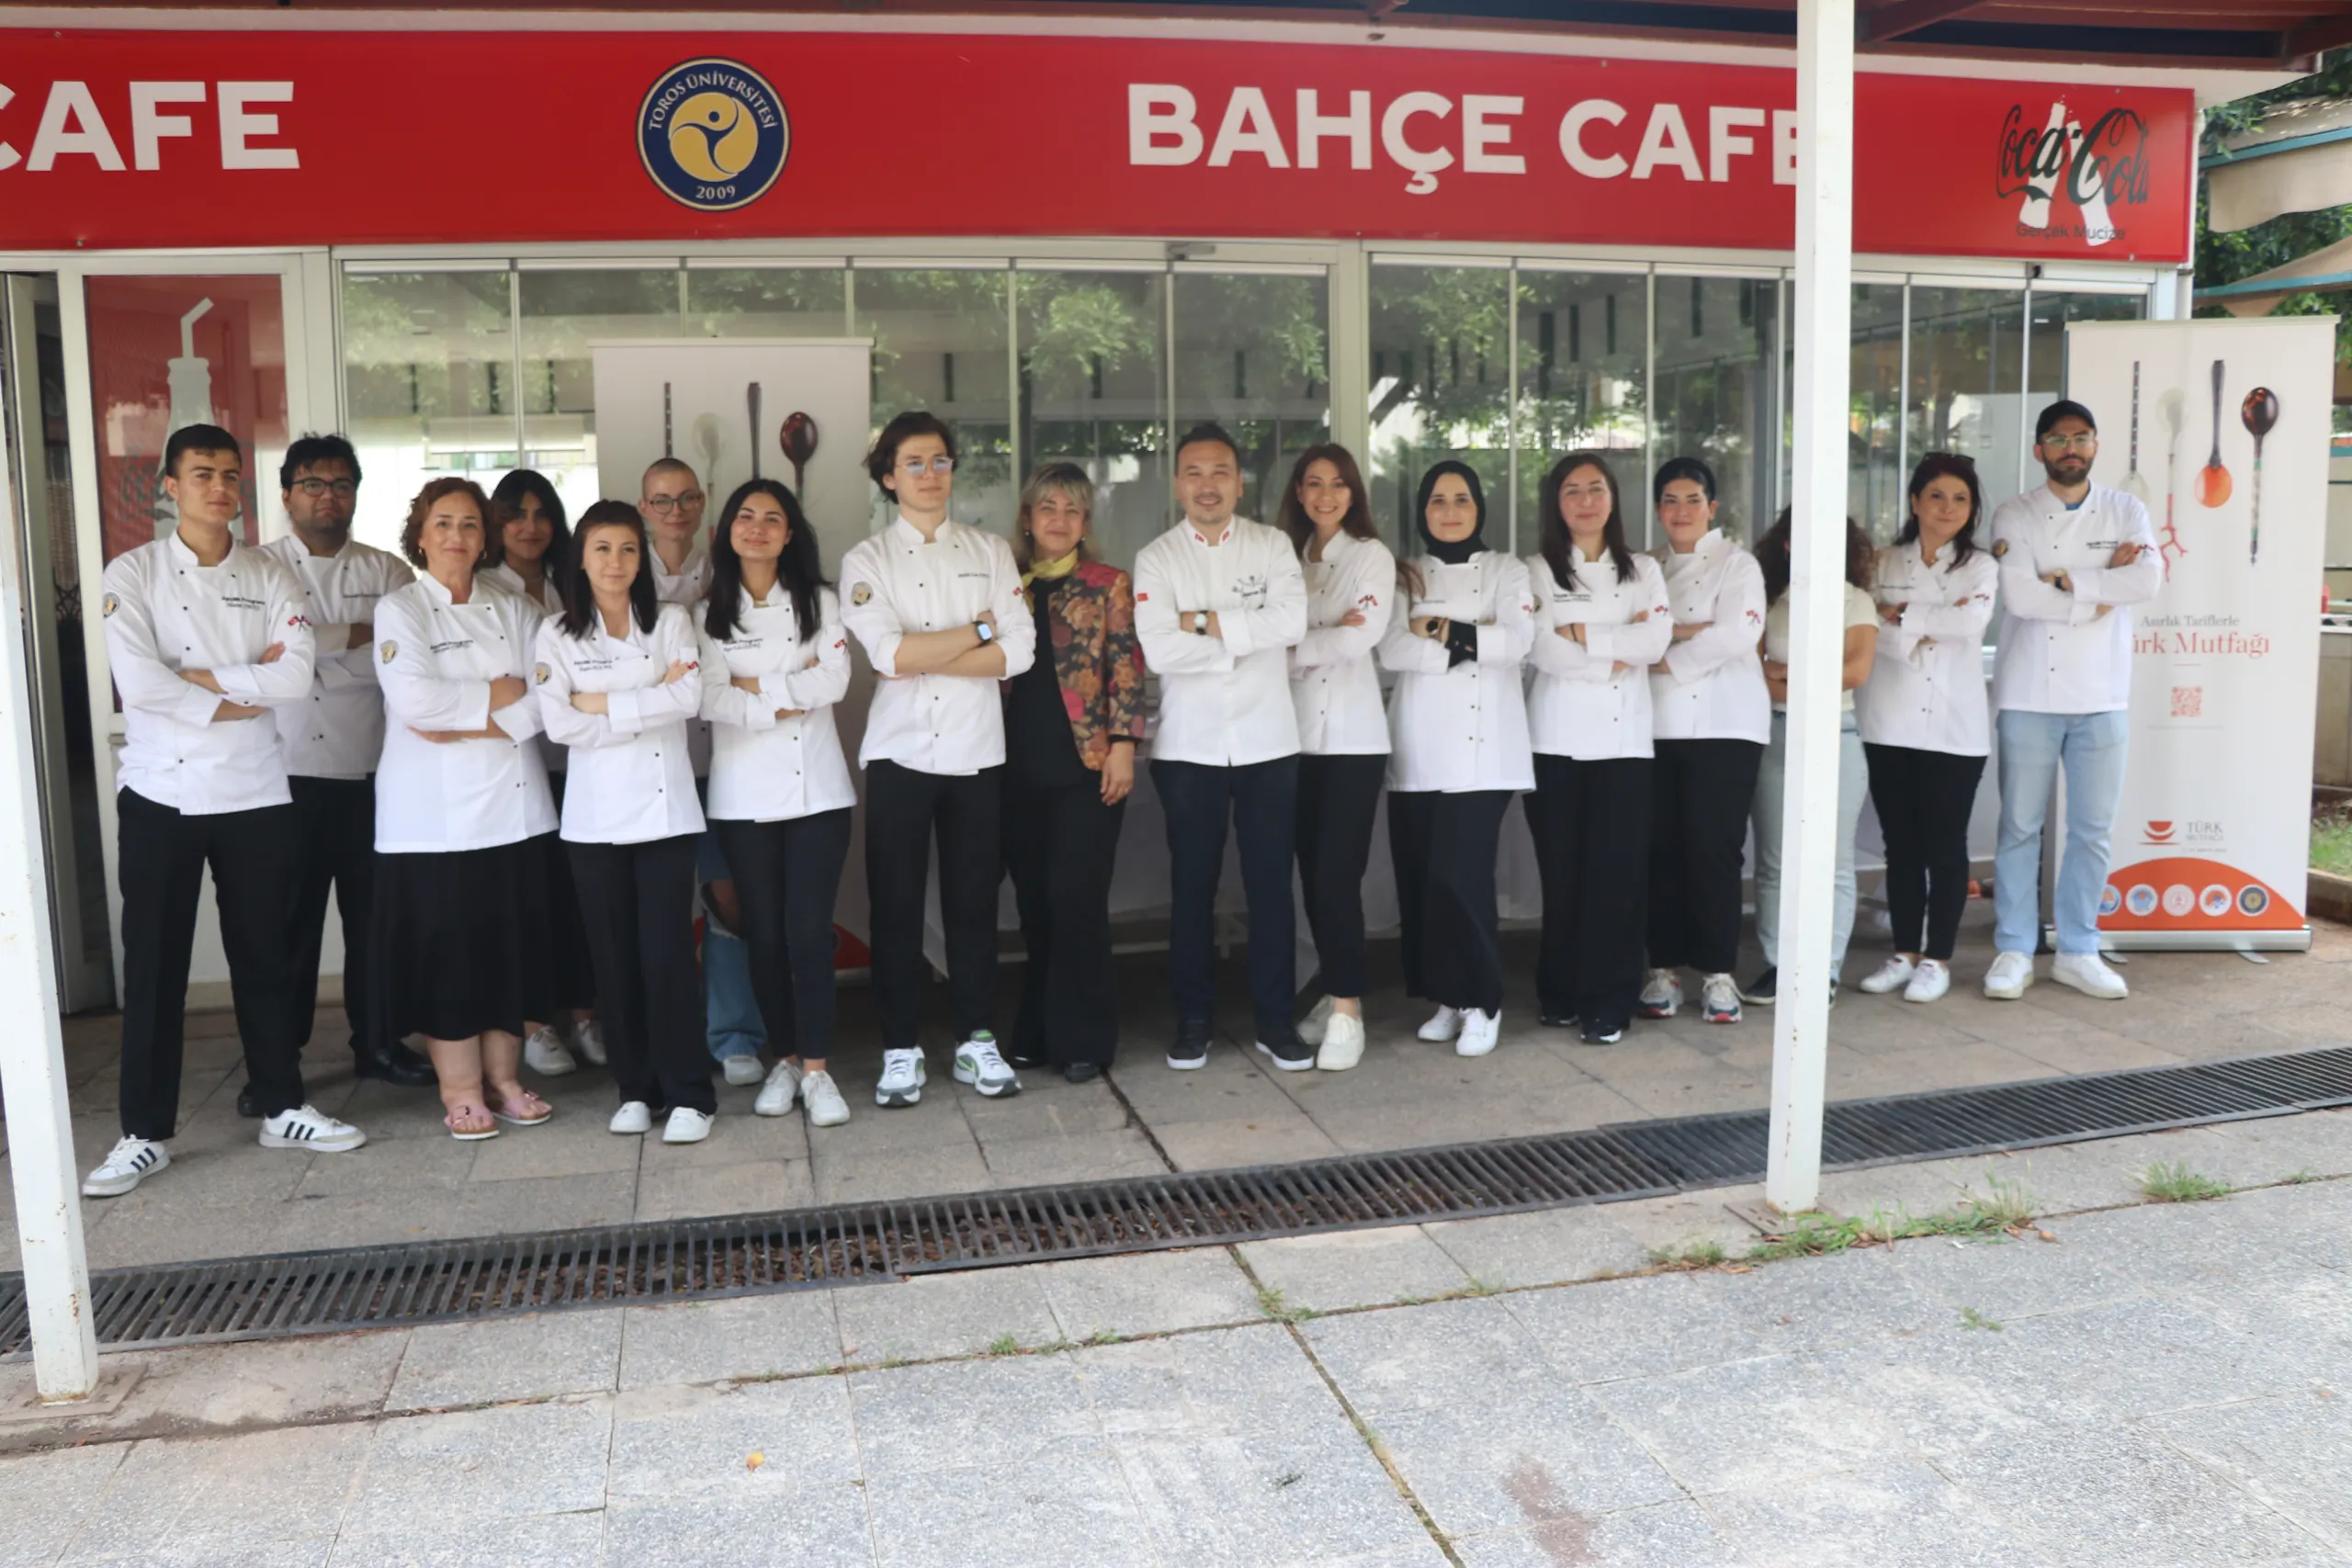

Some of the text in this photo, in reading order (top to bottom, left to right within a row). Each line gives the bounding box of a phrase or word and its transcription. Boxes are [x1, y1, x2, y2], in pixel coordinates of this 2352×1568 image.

[649, 70, 779, 130] TOROS ÜNİVERSİTESİ
[0, 80, 300, 172] AFE
[1127, 83, 1526, 195] BAHÇE
[695, 185, 737, 200] 2009
[2015, 223, 2126, 241] Gerçek Mucize
[2174, 631, 2270, 659] Mutfağı
[2186, 820, 2223, 834] TÜRK
